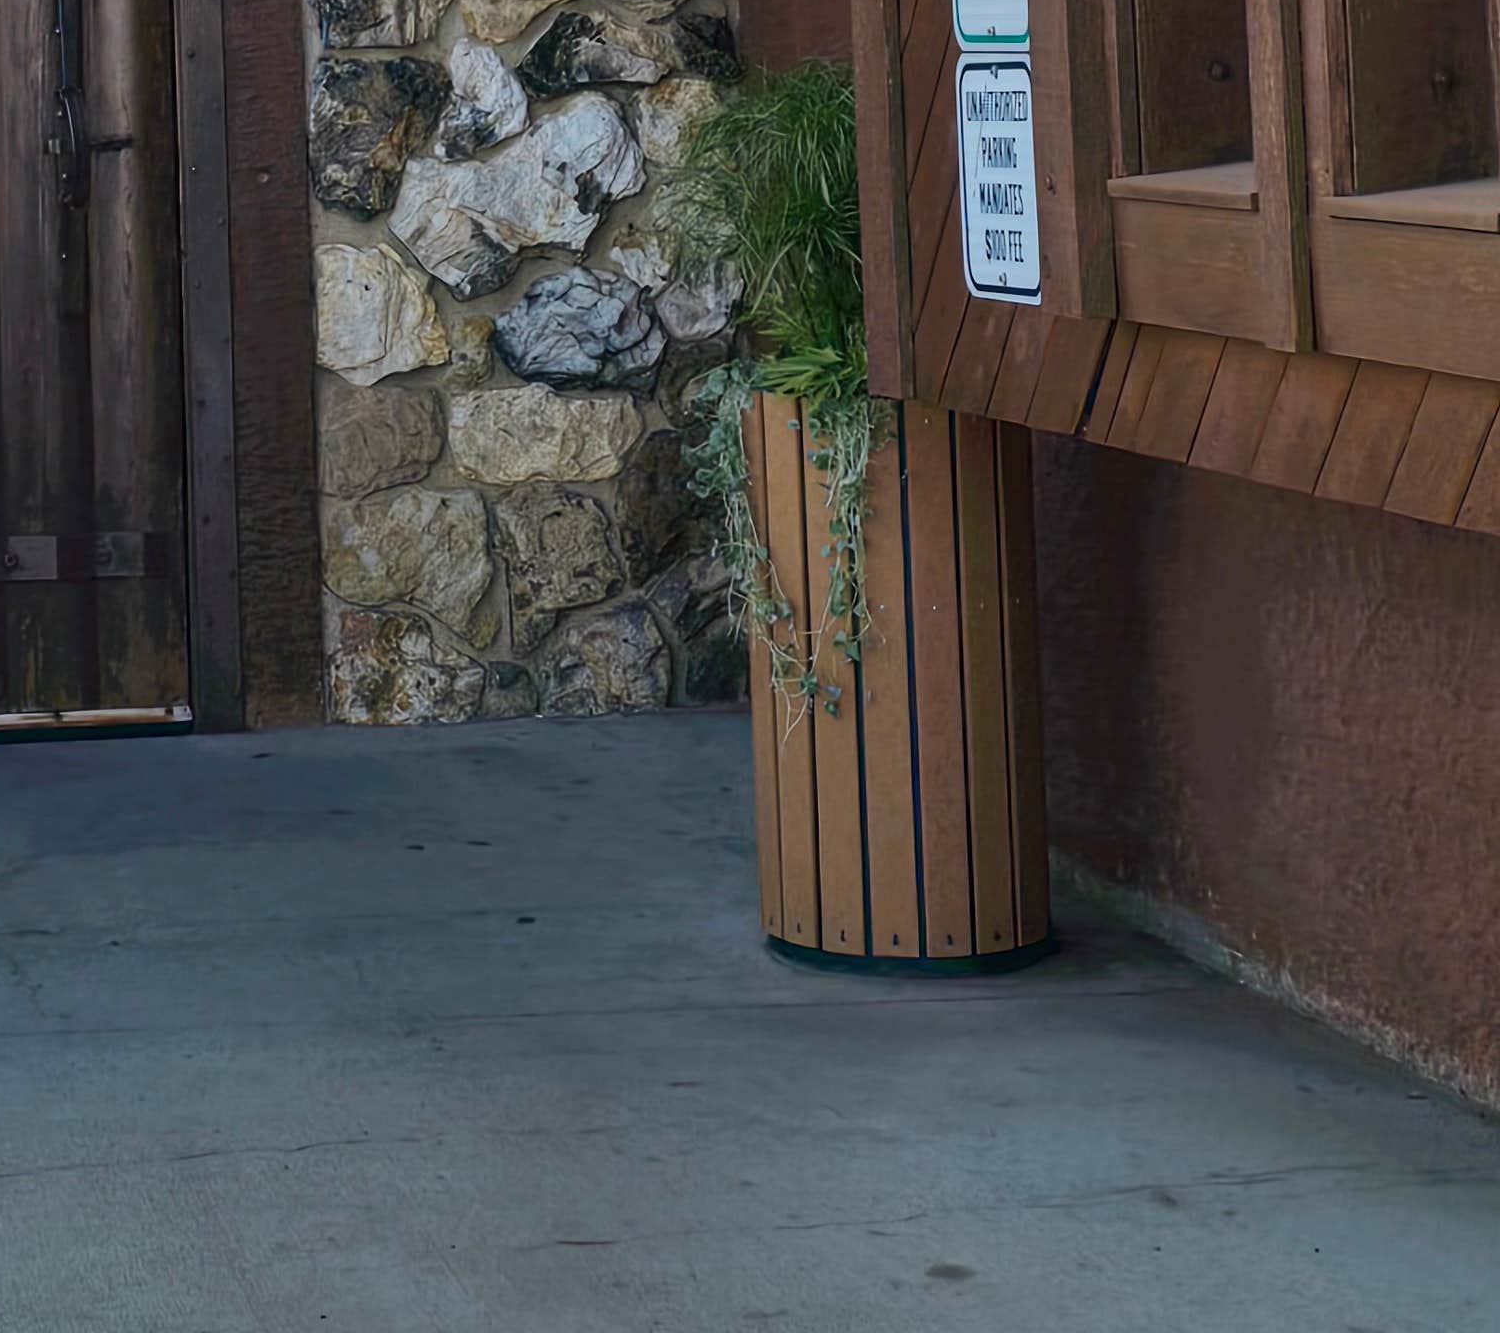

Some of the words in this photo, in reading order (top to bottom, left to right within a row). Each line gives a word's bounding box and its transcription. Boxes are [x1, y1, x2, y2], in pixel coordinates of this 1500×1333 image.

[965, 90, 1028, 122] UNAUTHORIZED
[981, 136, 1017, 169] PARKING
[979, 182, 1024, 216] MANDATES
[1008, 229, 1024, 263] FEE
